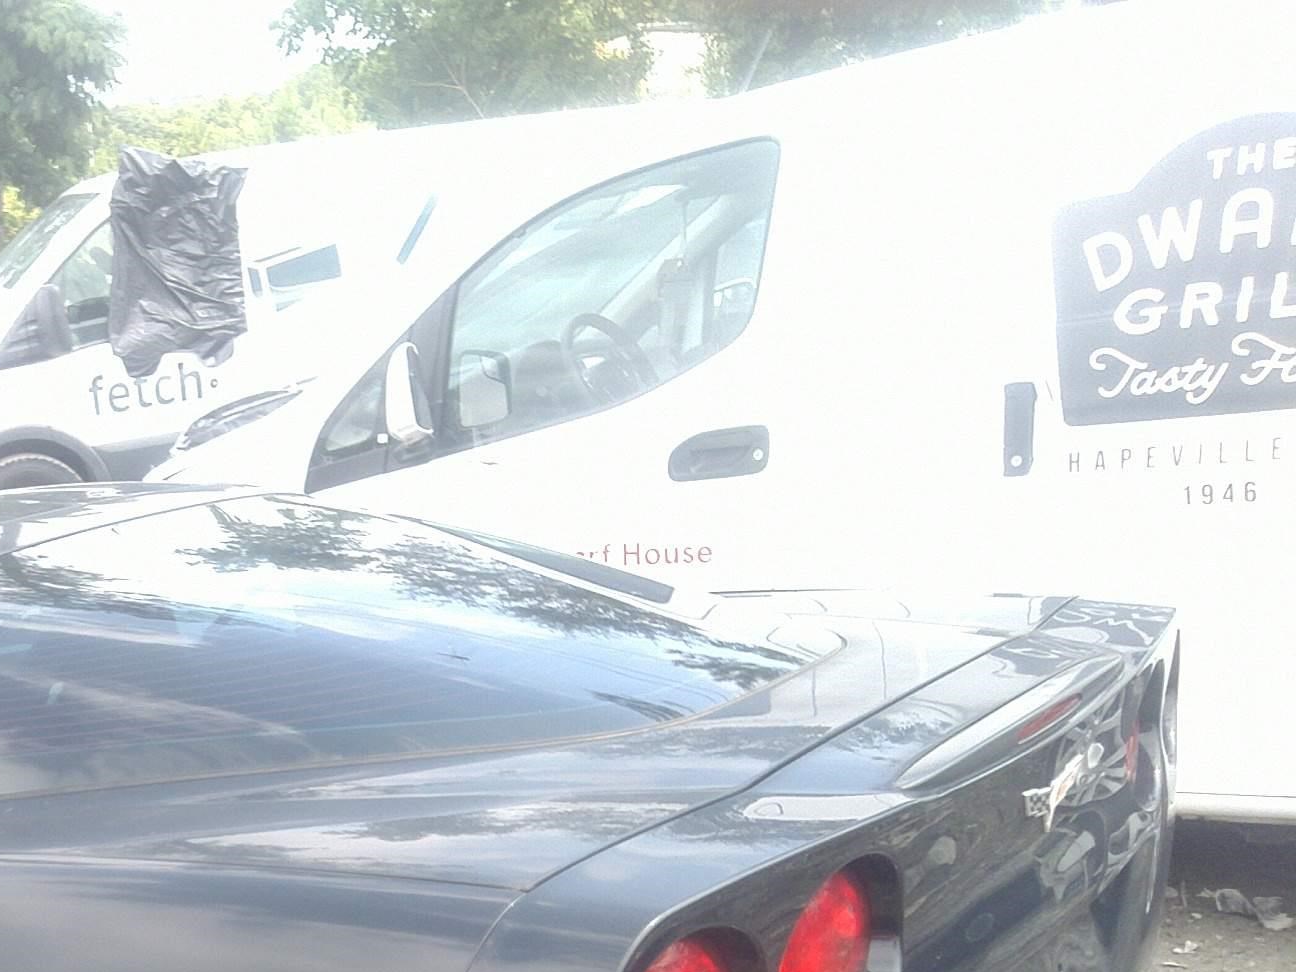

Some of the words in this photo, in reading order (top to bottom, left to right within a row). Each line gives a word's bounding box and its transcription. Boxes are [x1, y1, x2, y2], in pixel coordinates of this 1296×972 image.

[1206, 136, 1296, 181] THE
[1082, 186, 1296, 293] DWA
[88, 362, 203, 416] fetch
[1088, 346, 1230, 405] Tasty
[1068, 436, 1282, 473] HAPEVILLE
[1183, 481, 1257, 505] 1946
[622, 543, 714, 566] House
